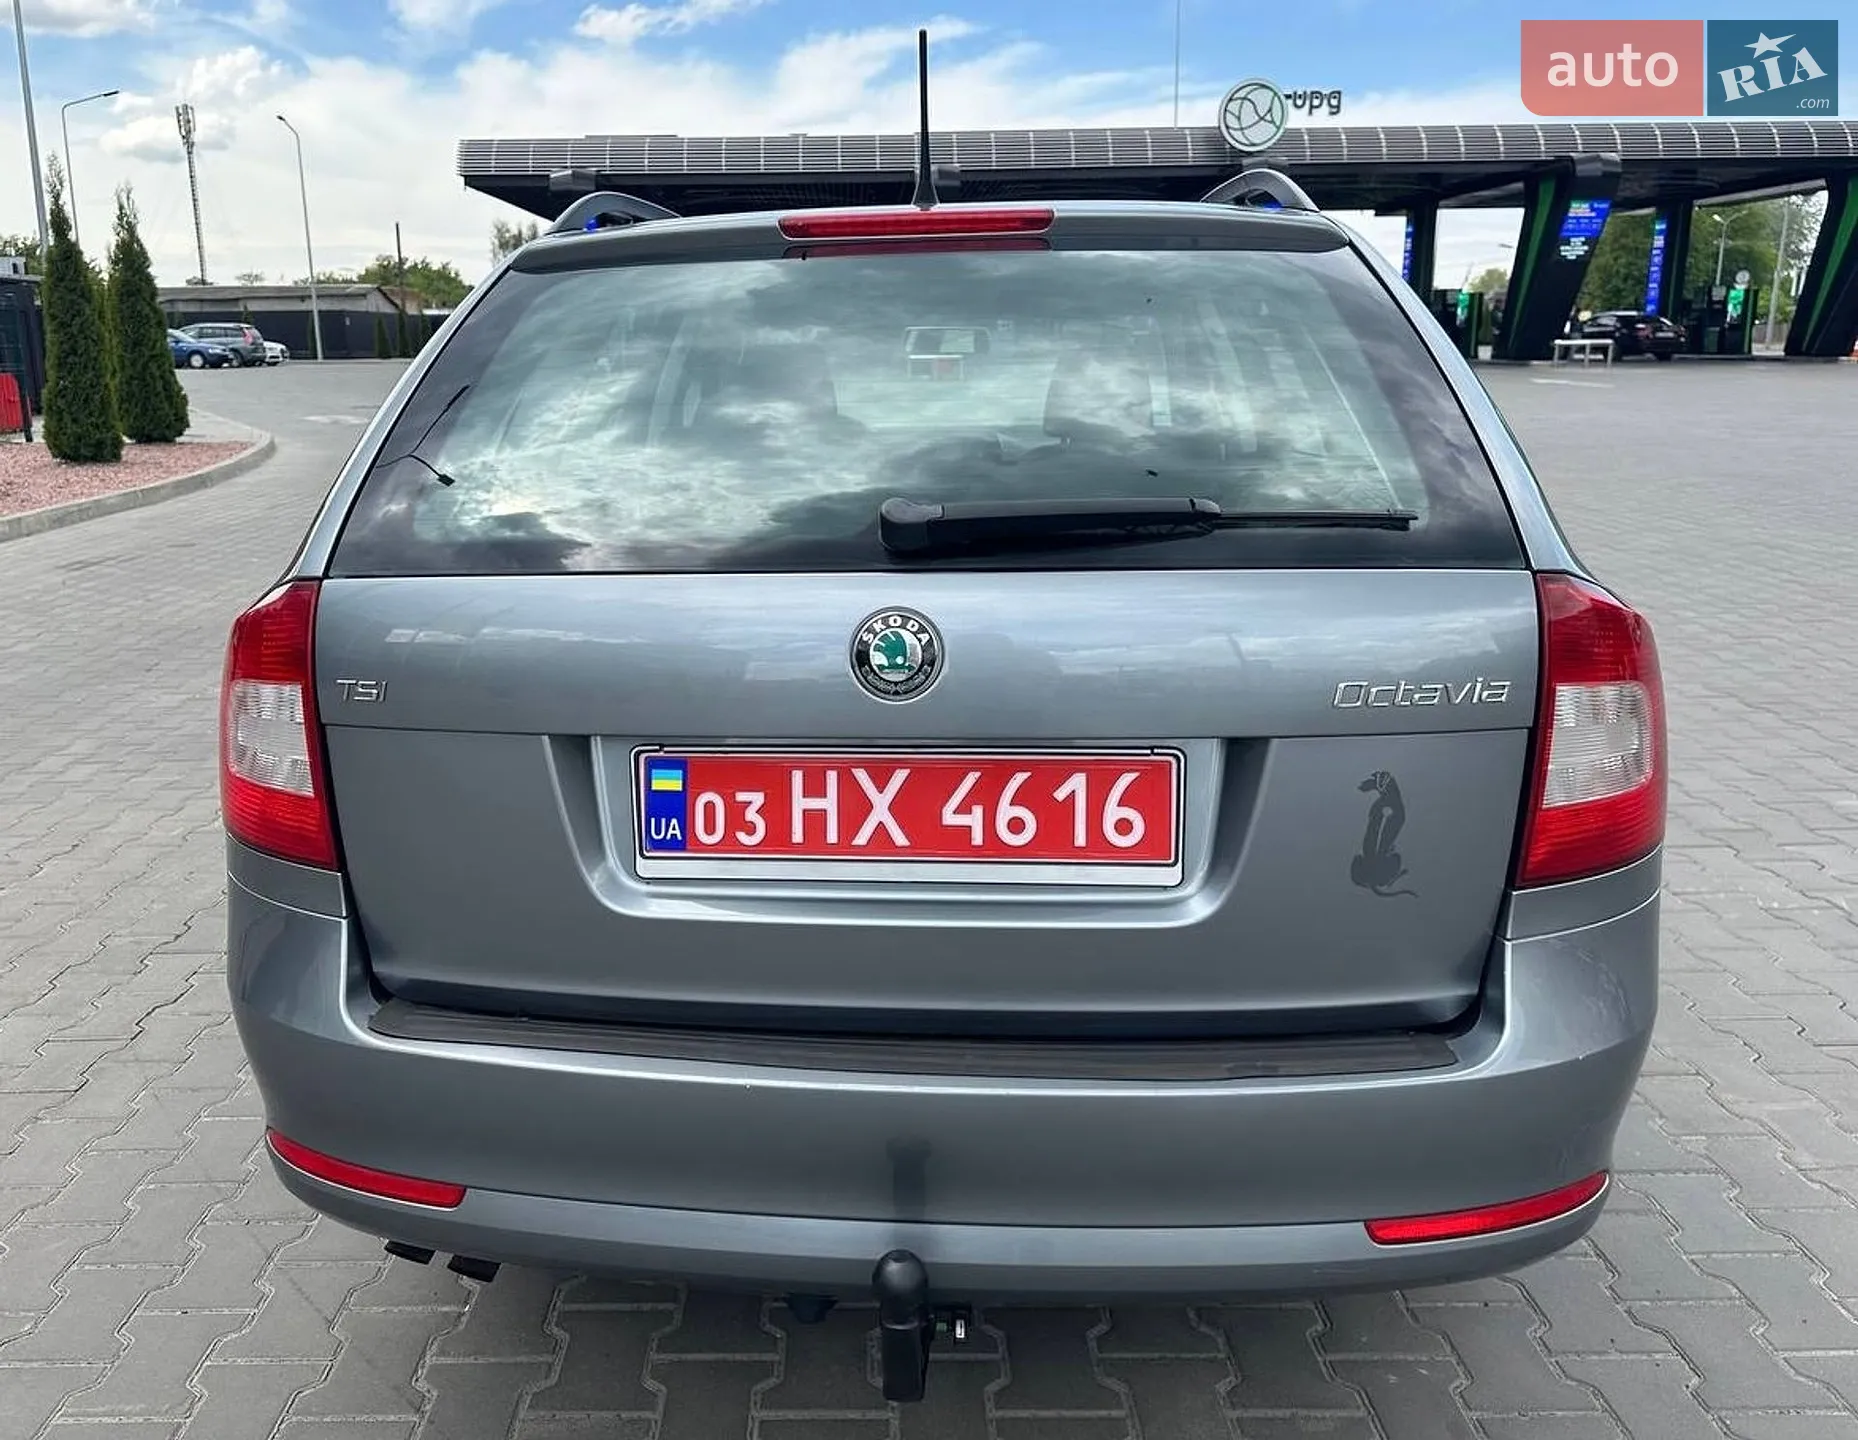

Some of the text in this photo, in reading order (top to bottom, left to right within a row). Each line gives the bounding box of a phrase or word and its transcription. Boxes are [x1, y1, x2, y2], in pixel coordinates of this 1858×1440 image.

[1293, 90, 1342, 116] upg
[336, 679, 388, 702] TSI
[1333, 677, 1512, 708] Octavia
[693, 767, 1147, 848] 03 HX 4616
[650, 817, 682, 841] UA
